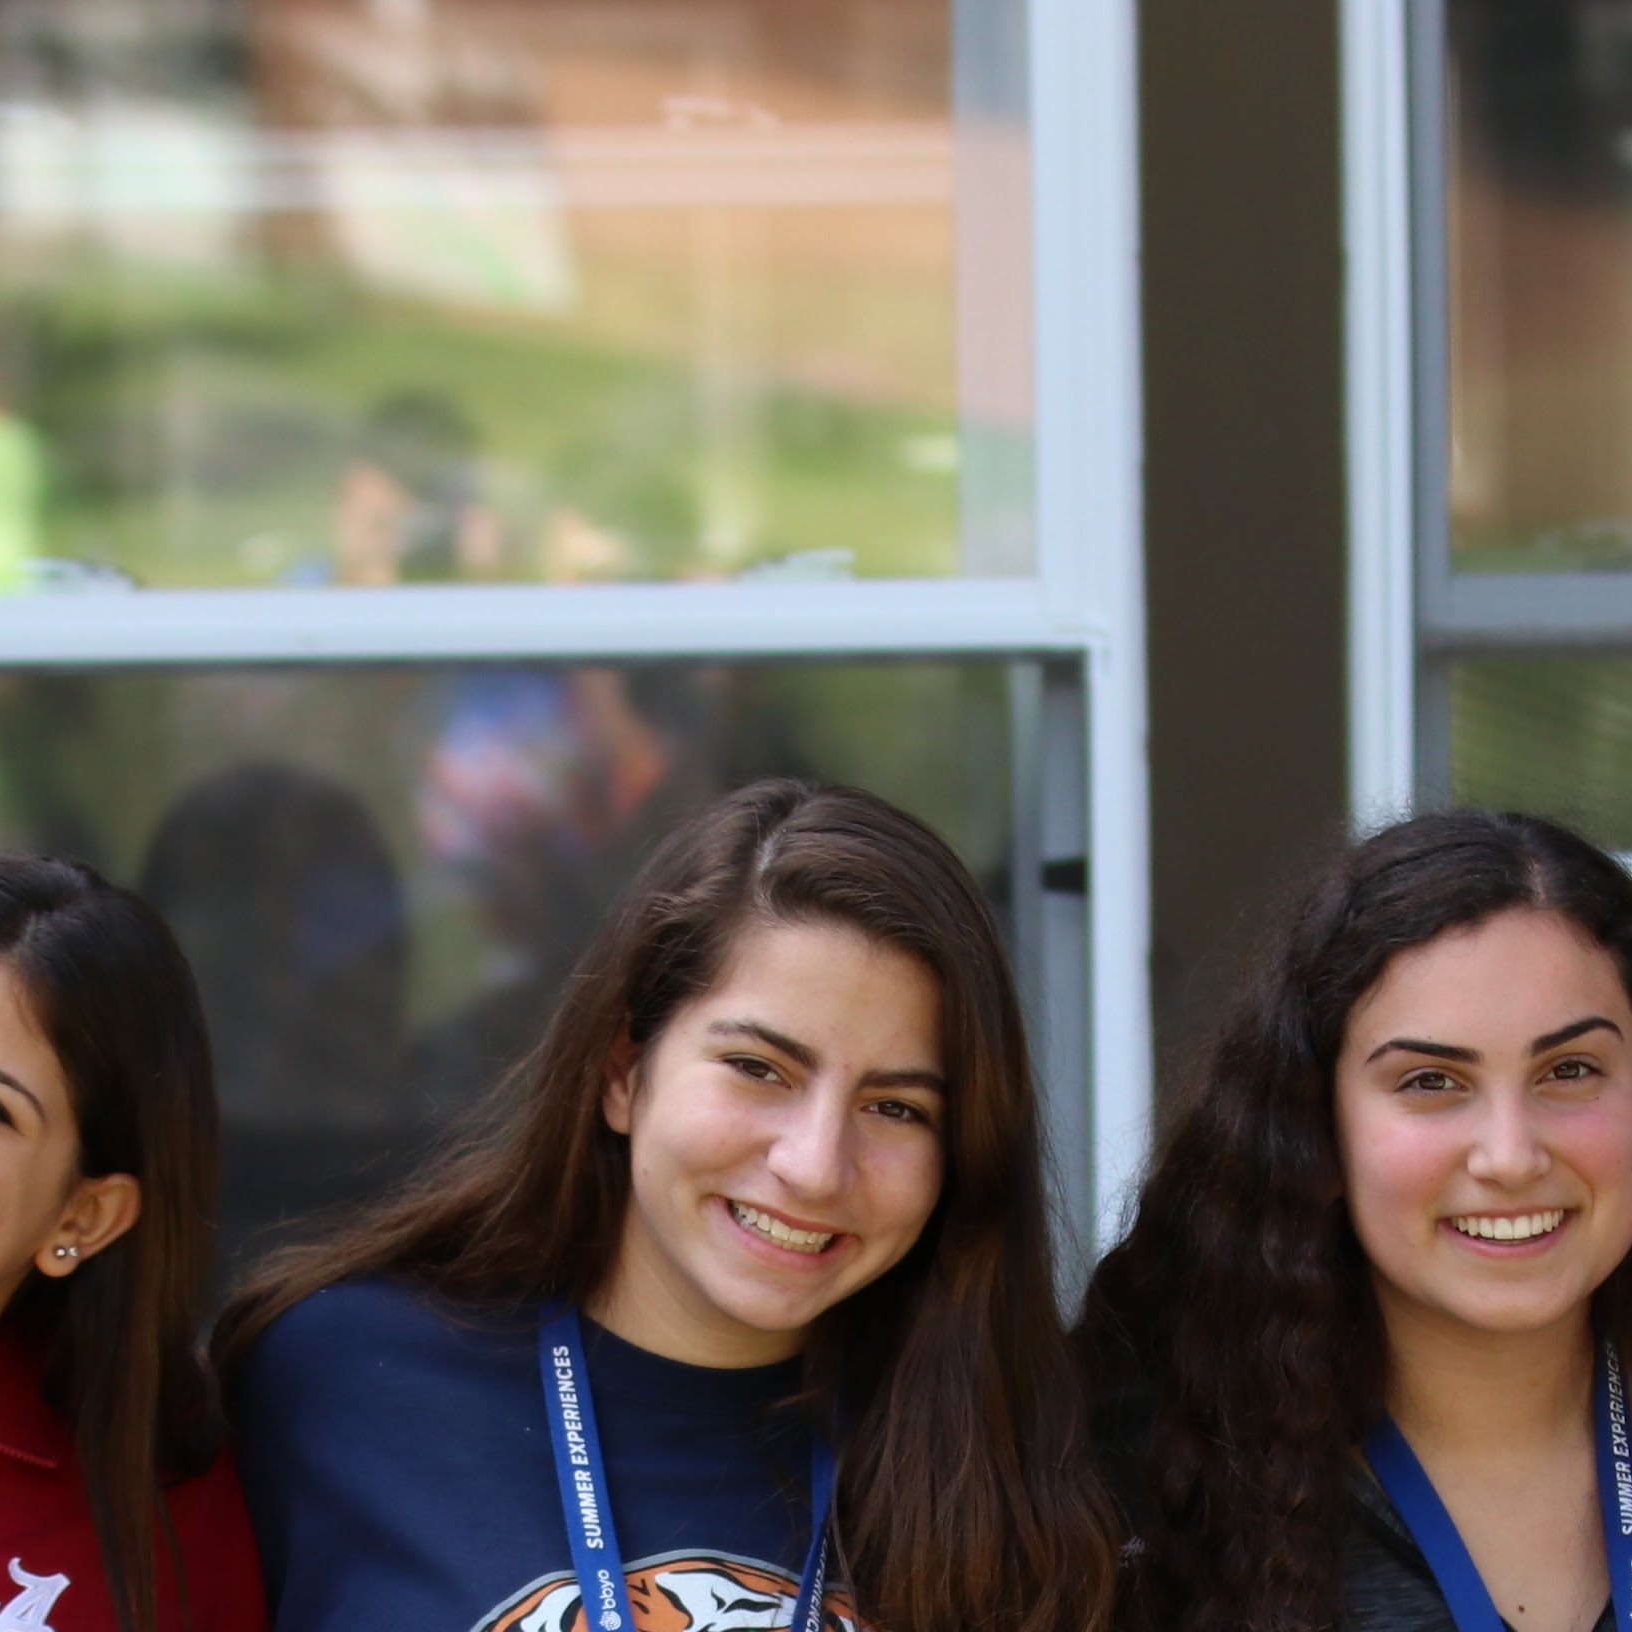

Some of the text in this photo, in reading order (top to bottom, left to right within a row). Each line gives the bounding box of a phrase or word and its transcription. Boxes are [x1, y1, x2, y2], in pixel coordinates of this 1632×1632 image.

[552, 1346, 603, 1549] SUMMER EXPERIENCES
[1607, 1341, 1629, 1457] EXPERIENCE
[598, 1569, 618, 1611] bbyo
